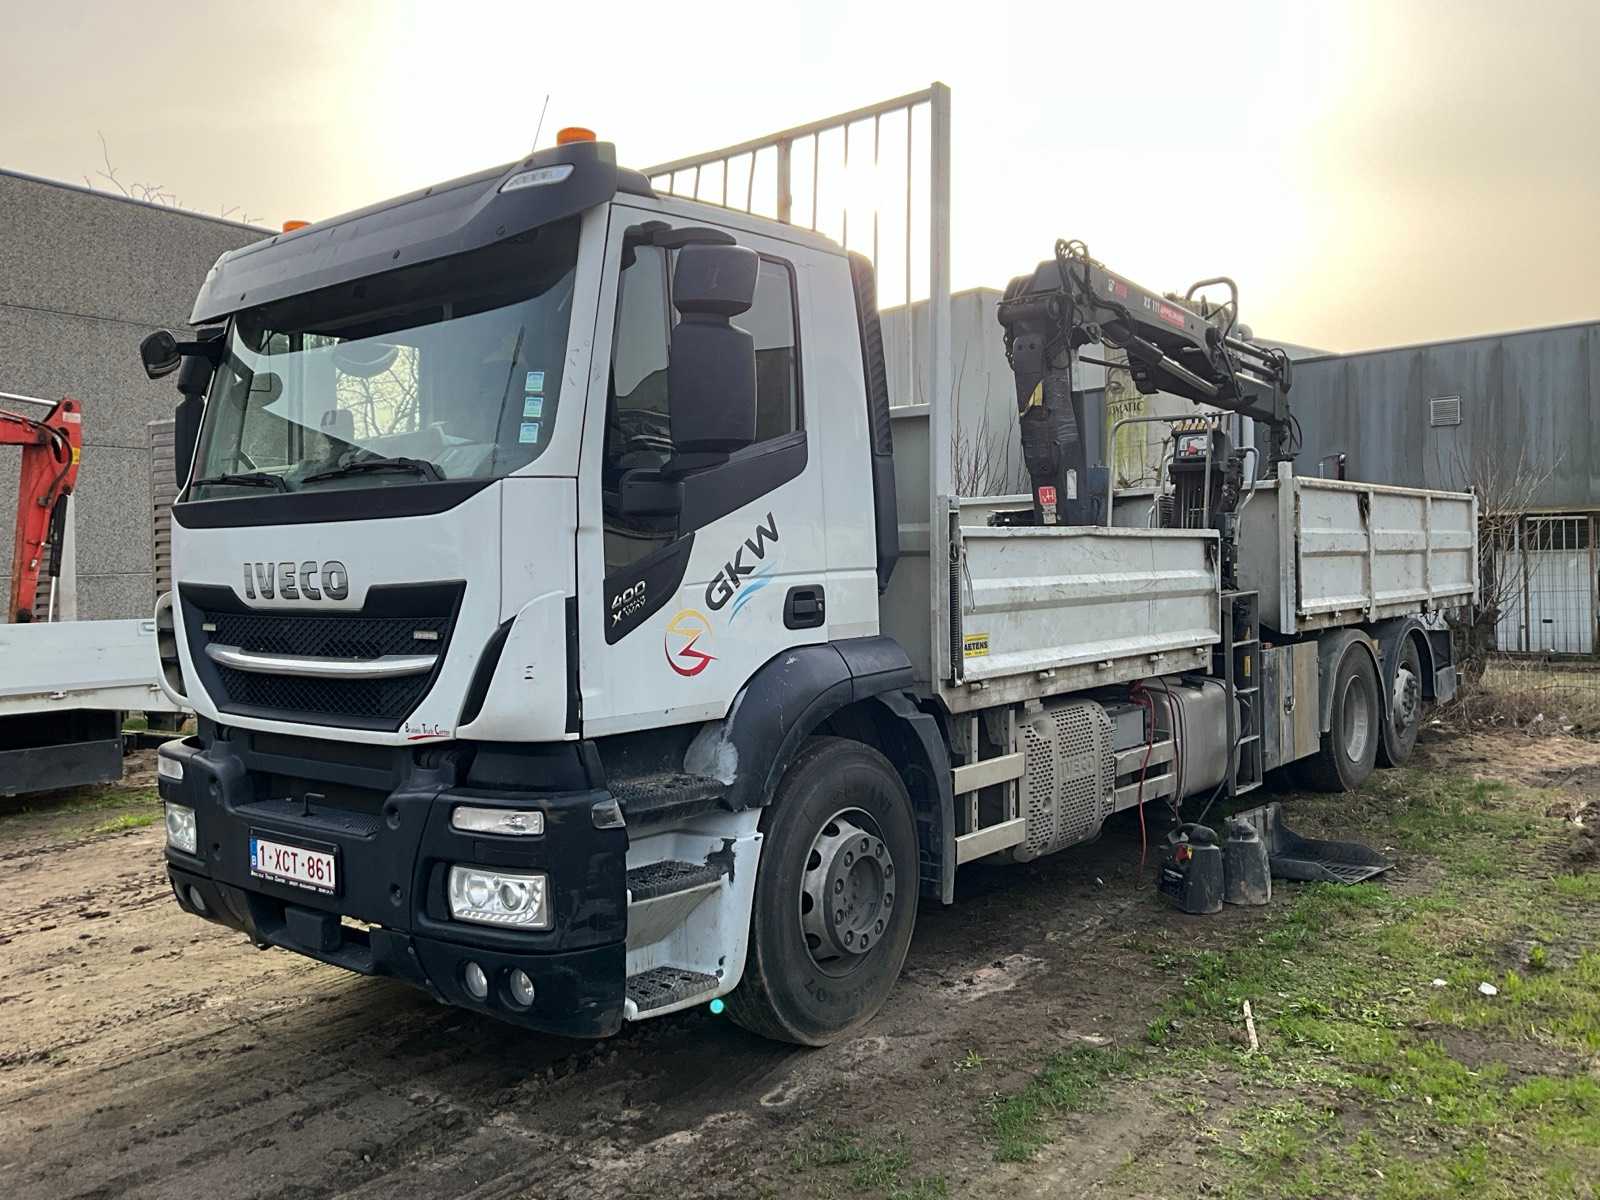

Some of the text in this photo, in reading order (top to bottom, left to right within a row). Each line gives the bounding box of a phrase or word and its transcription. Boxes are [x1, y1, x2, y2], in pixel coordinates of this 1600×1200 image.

[705, 511, 779, 611] GKW
[243, 560, 349, 601] IVECO
[611, 580, 646, 609] 400
[1060, 754, 1096, 779] IVECO
[260, 845, 332, 882] 1-XCT-861
